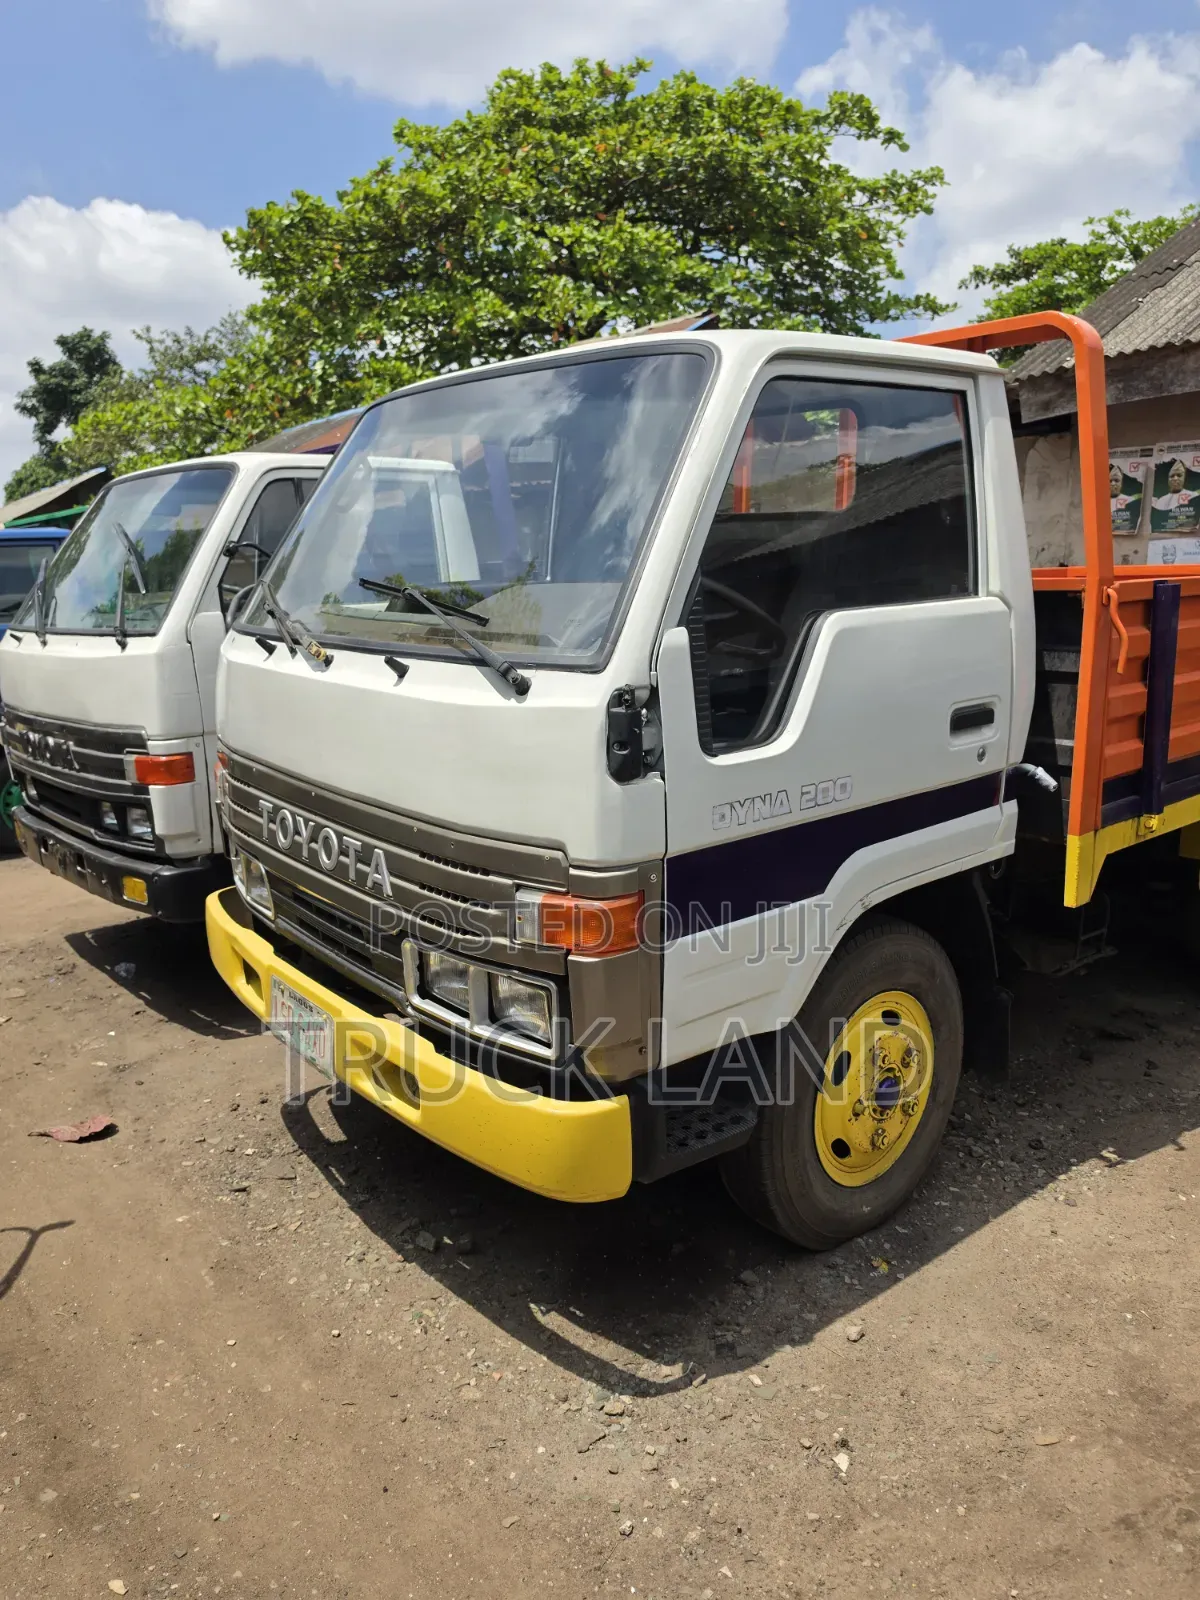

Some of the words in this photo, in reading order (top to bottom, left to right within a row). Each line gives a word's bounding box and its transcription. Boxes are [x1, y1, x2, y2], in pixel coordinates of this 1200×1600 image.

[712, 790, 792, 830] DYNA
[800, 775, 854, 811] 200
[258, 799, 393, 899] TOYOTA
